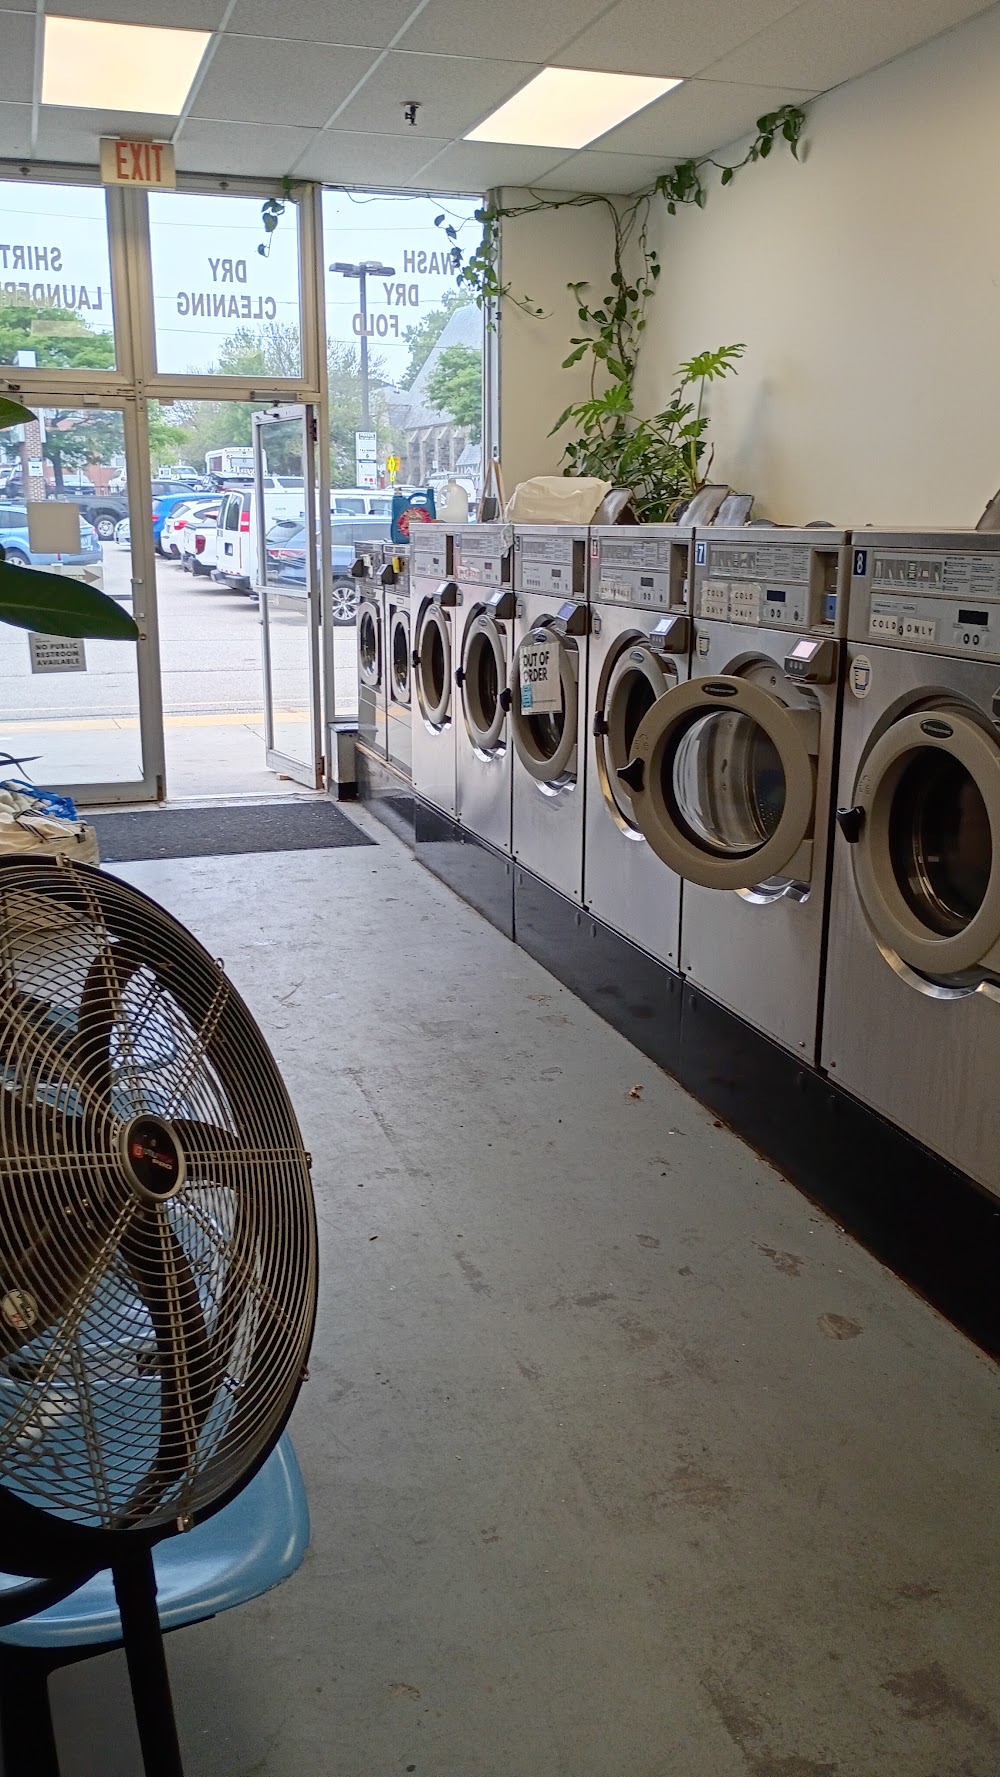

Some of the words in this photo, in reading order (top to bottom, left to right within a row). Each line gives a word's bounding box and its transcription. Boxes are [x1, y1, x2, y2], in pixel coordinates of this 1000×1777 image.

[115, 142, 163, 182] EXIT
[699, 544, 704, 563] 7
[856, 553, 863, 573] 8
[707, 589, 724, 598] COLD
[735, 592, 753, 600] COLD
[872, 619, 897, 630] COLD
[906, 624, 933, 636] ONLY
[523, 652, 538, 667] OUT
[539, 650, 550, 665] OF
[523, 667, 548, 683] ORDER
